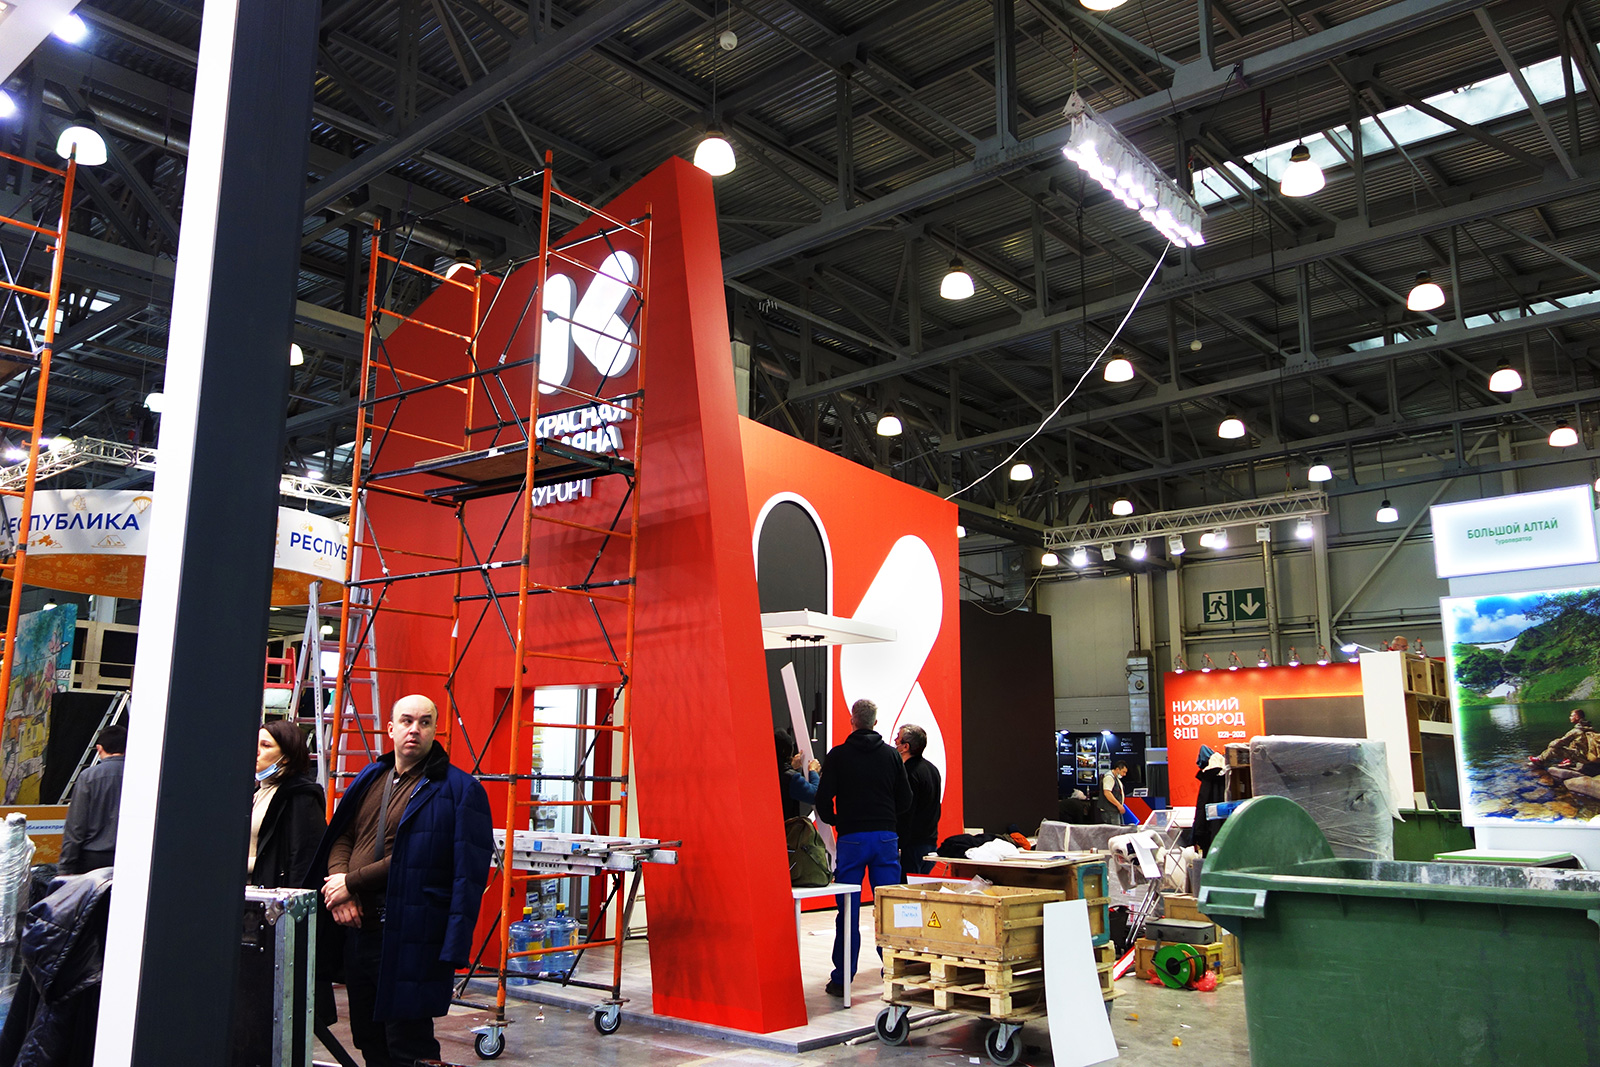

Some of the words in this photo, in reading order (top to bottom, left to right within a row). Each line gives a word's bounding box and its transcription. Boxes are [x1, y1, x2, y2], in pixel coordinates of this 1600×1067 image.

[1467, 521, 1521, 539] БОЛЬШОЙ
[1523, 517, 1558, 532] АЛТАЙ
[1172, 697, 1239, 712] НИЖНИЙ
[1173, 712, 1246, 726] НОВГОРОД
